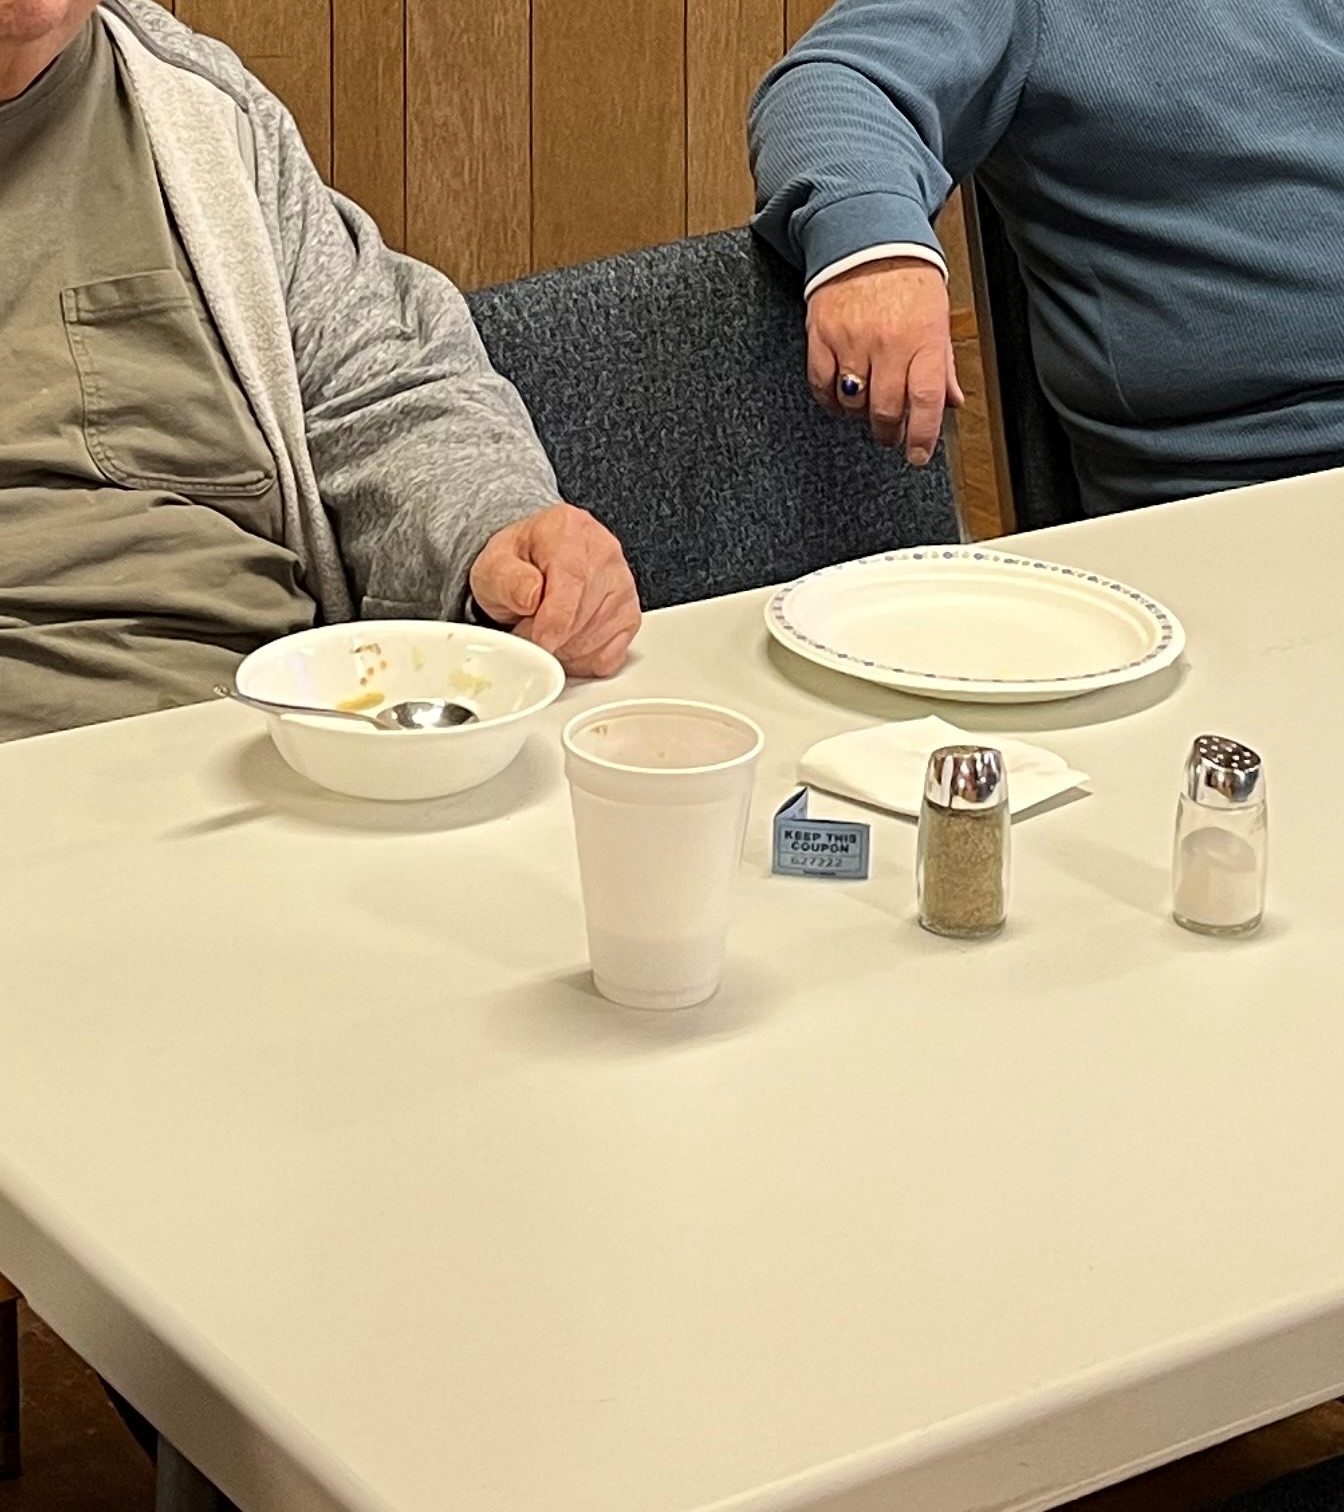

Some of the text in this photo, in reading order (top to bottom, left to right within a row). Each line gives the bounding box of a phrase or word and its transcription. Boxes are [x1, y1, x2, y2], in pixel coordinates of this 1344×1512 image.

[784, 830, 857, 844] KEEP THIS
[791, 841, 850, 853] COUPON
